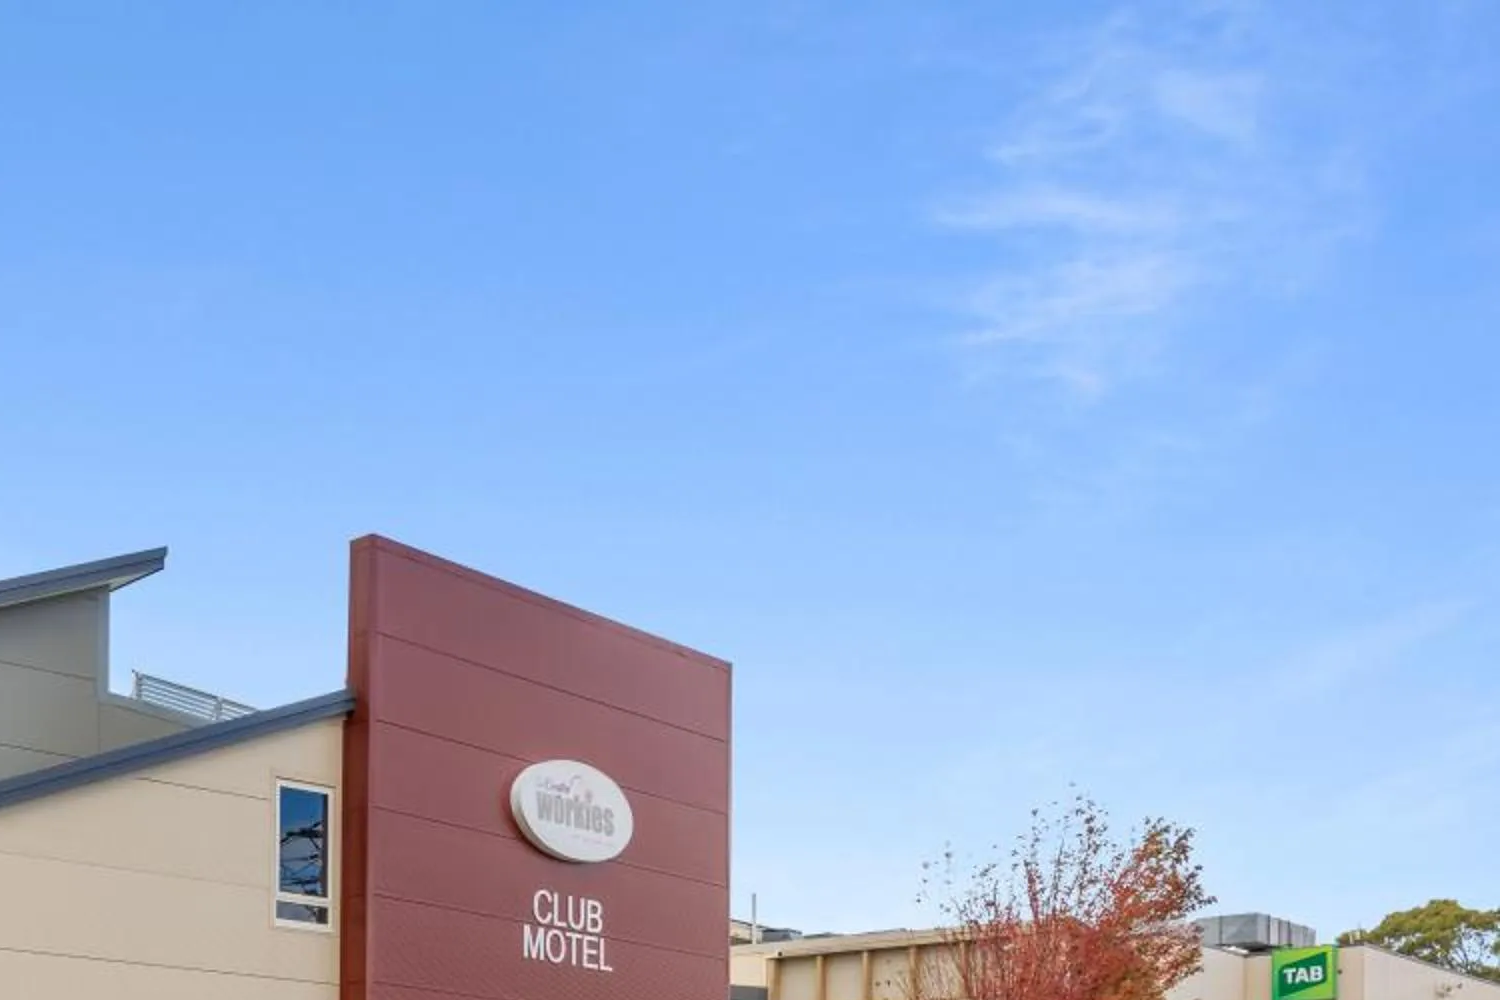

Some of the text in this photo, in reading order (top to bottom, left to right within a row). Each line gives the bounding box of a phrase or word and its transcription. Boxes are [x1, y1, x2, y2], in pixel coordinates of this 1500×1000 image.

[533, 889, 603, 933] CLUB
[523, 924, 613, 971] MOTEL
[1283, 966, 1323, 984] TAB
